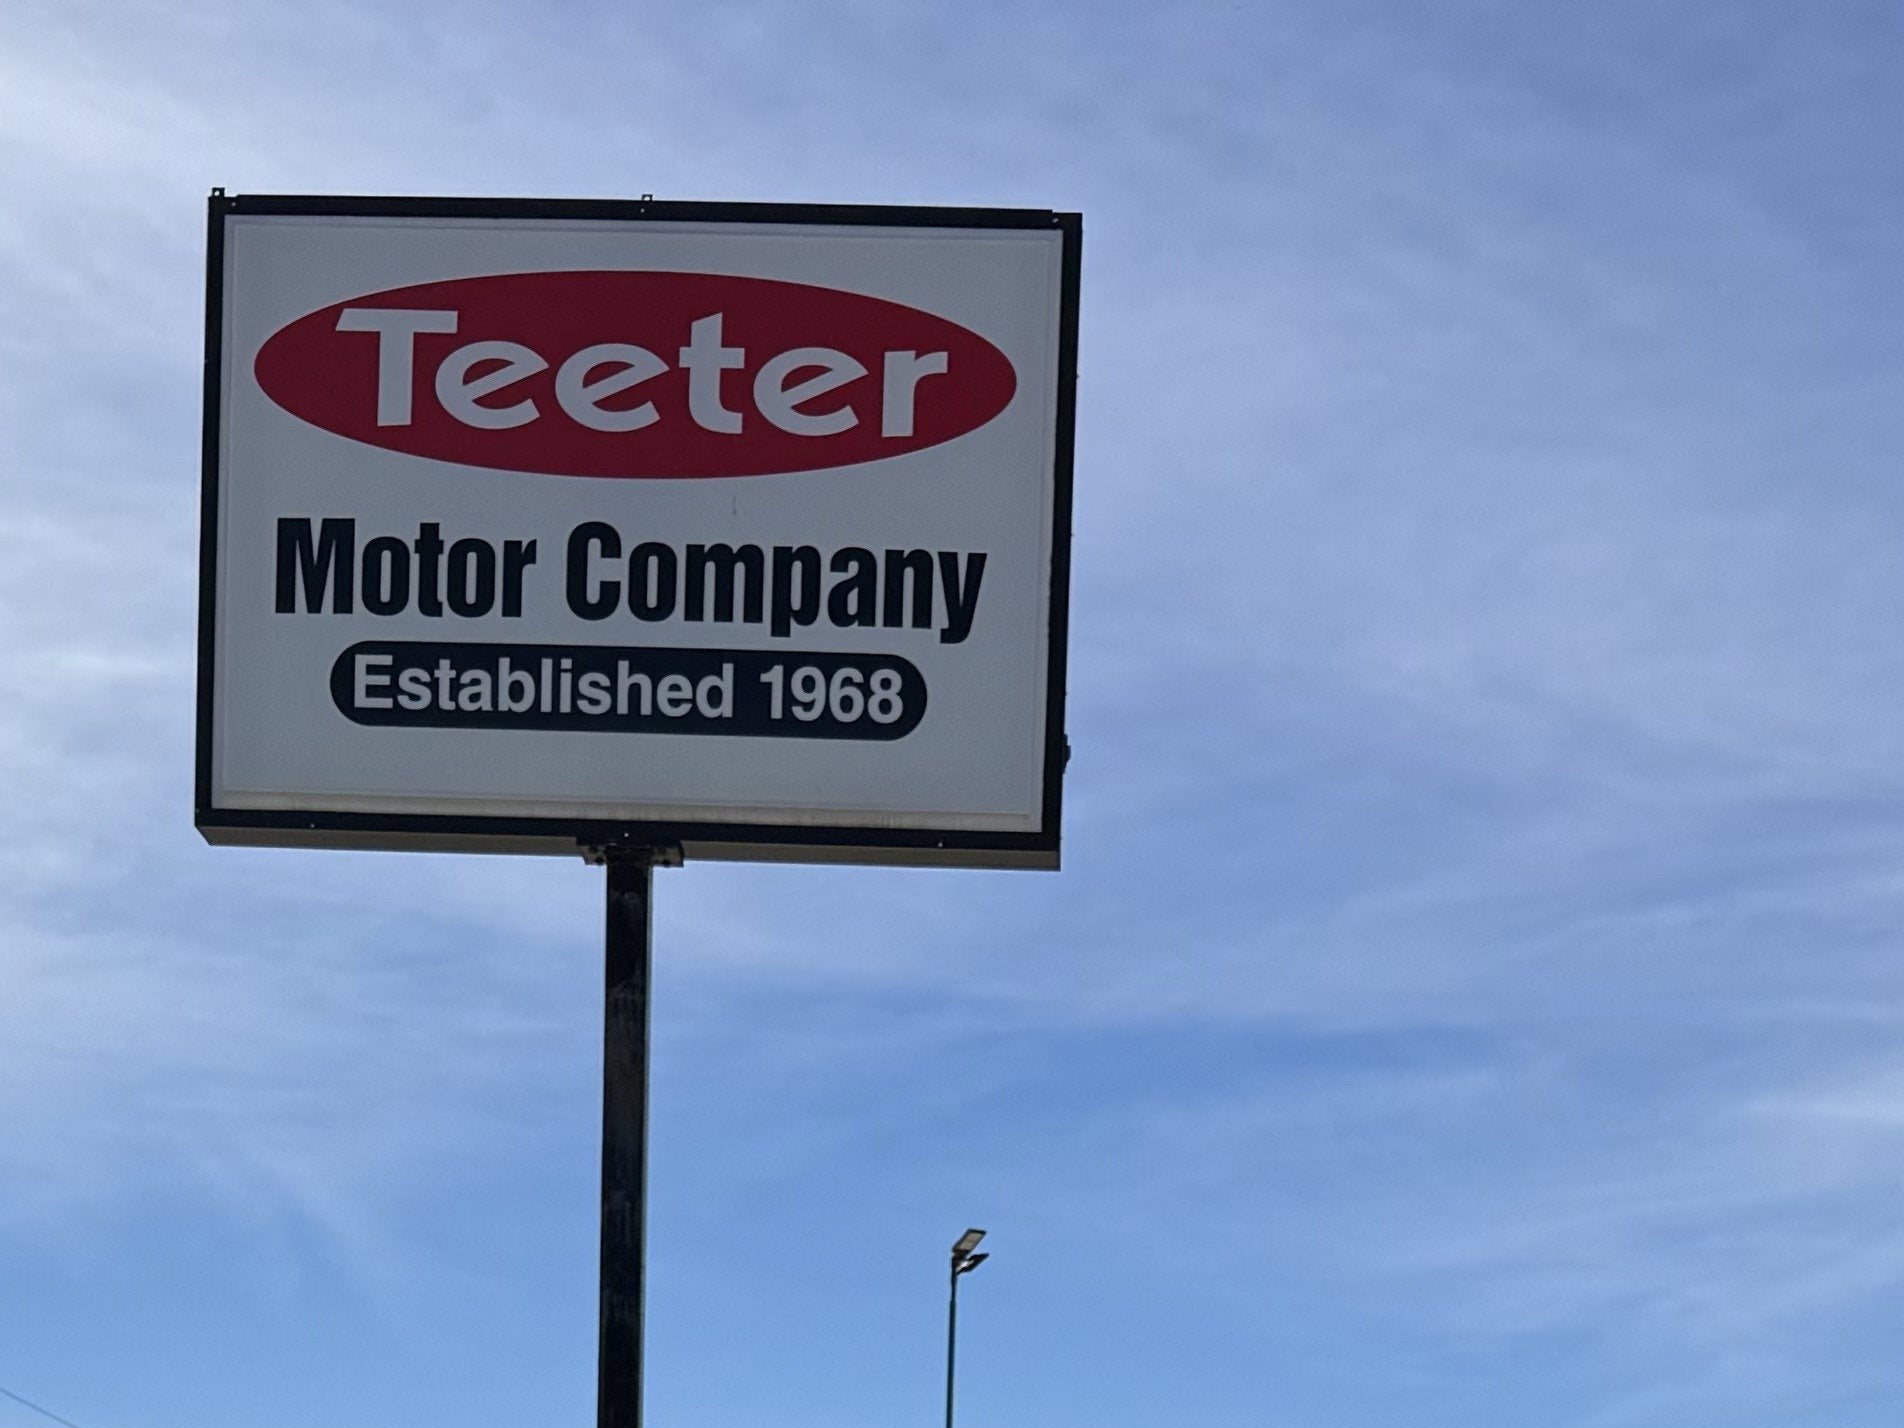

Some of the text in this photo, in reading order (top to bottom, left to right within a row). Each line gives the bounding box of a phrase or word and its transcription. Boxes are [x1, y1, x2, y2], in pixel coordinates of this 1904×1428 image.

[334, 306, 949, 437] Teeter
[274, 517, 988, 645] Motor Company
[352, 653, 906, 725] Established 1968
